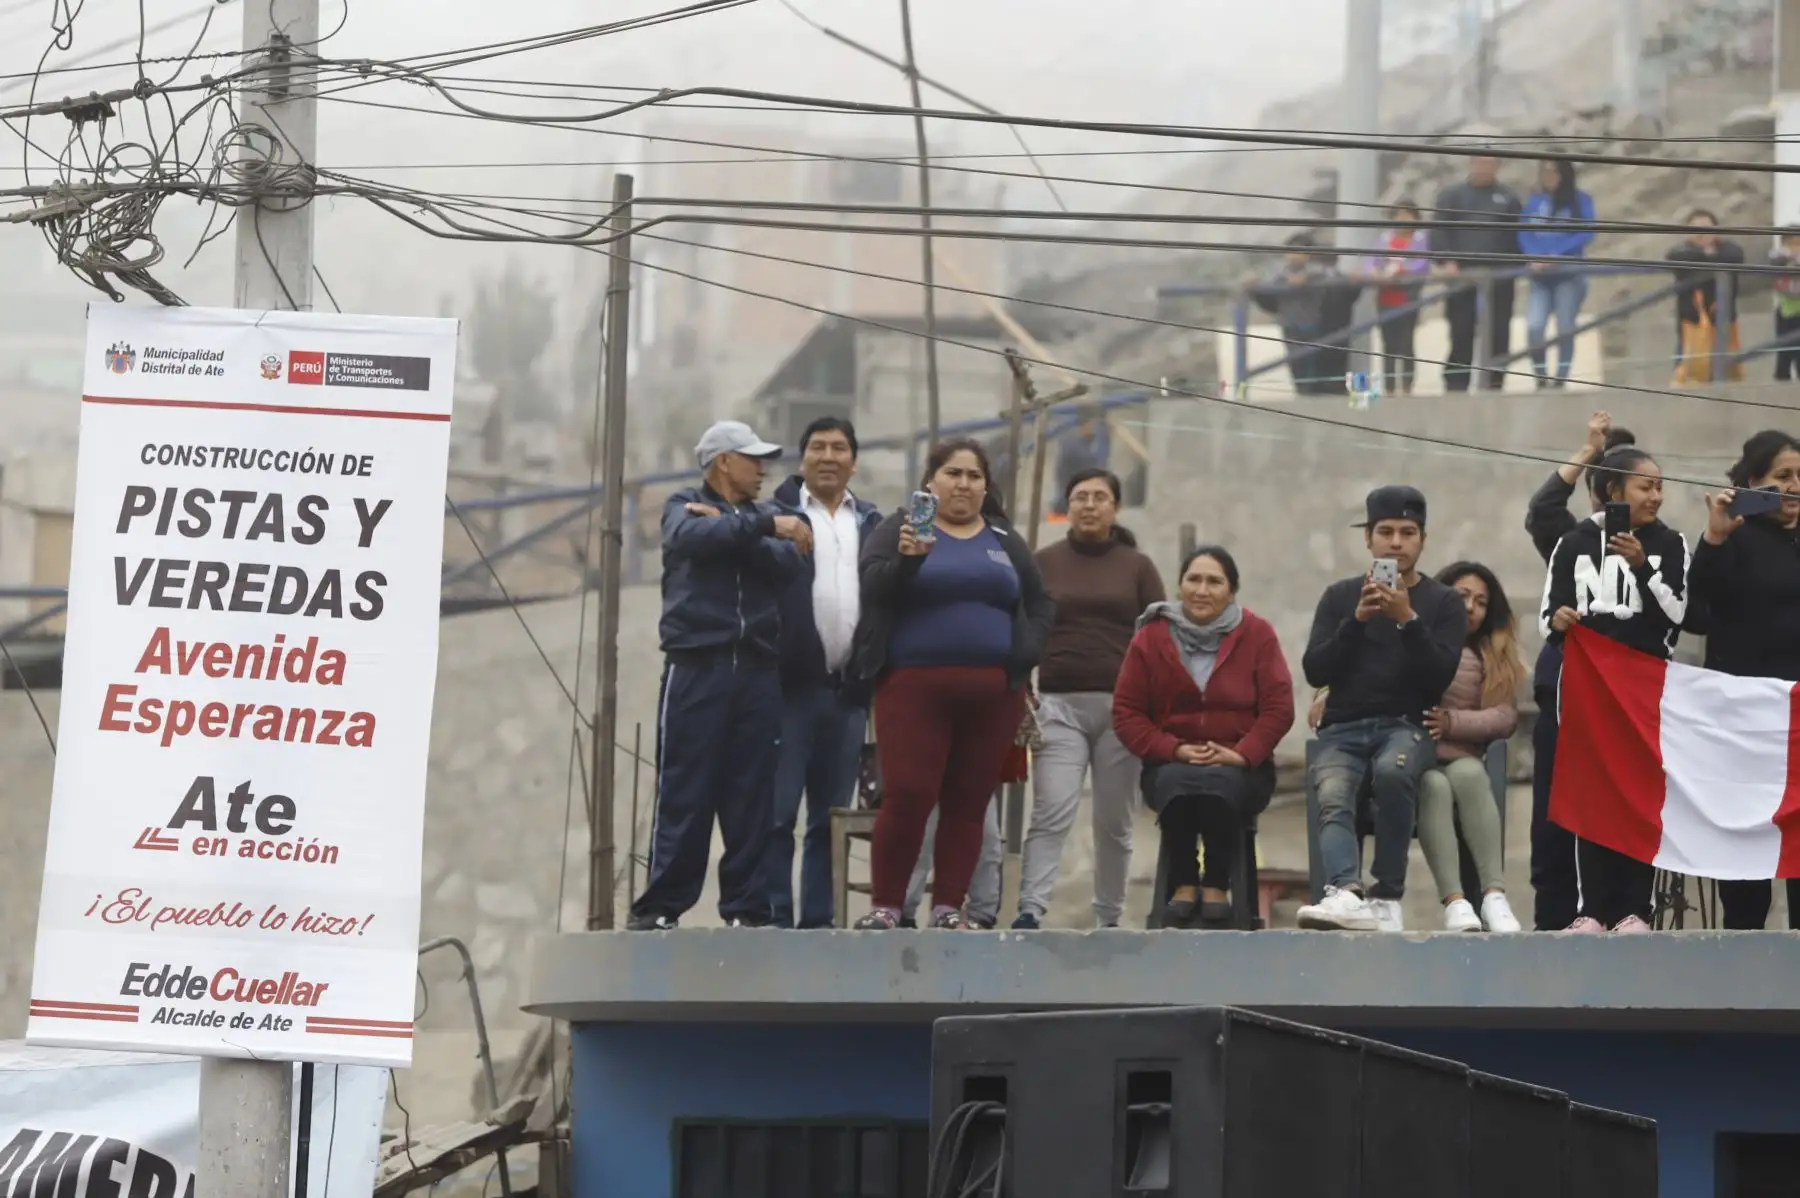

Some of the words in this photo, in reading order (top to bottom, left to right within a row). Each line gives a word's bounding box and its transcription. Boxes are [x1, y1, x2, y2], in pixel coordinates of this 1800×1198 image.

[144, 346, 224, 362] Municipalidad
[293, 361, 321, 374] PERÚ
[330, 357, 373, 367] Ministerio
[142, 362, 185, 374] Distrital
[188, 364, 201, 375] de
[205, 365, 224, 376] Ate
[329, 365, 341, 373] de
[342, 366, 392, 377] Transportes
[329, 375, 334, 383] y
[336, 375, 404, 385] Comunicaciones
[141, 444, 334, 474] CONSTRUCCIÓN
[341, 455, 373, 476] DE
[116, 486, 329, 545] PISTAS
[353, 498, 393, 547] Y
[115, 557, 387, 620] VEREDAS
[135, 627, 346, 685] Avenida
[99, 684, 375, 747] Esperanza
[167, 776, 296, 835] Ate
[193, 837, 228, 856] en
[238, 837, 338, 864] acción
[151, 903, 254, 931] pueblo
[259, 905, 288, 929] lo
[291, 907, 375, 935] hizo!
[151, 1007, 225, 1027] Alcalde
[230, 1012, 254, 1029] de
[257, 1014, 292, 1031] Ate
